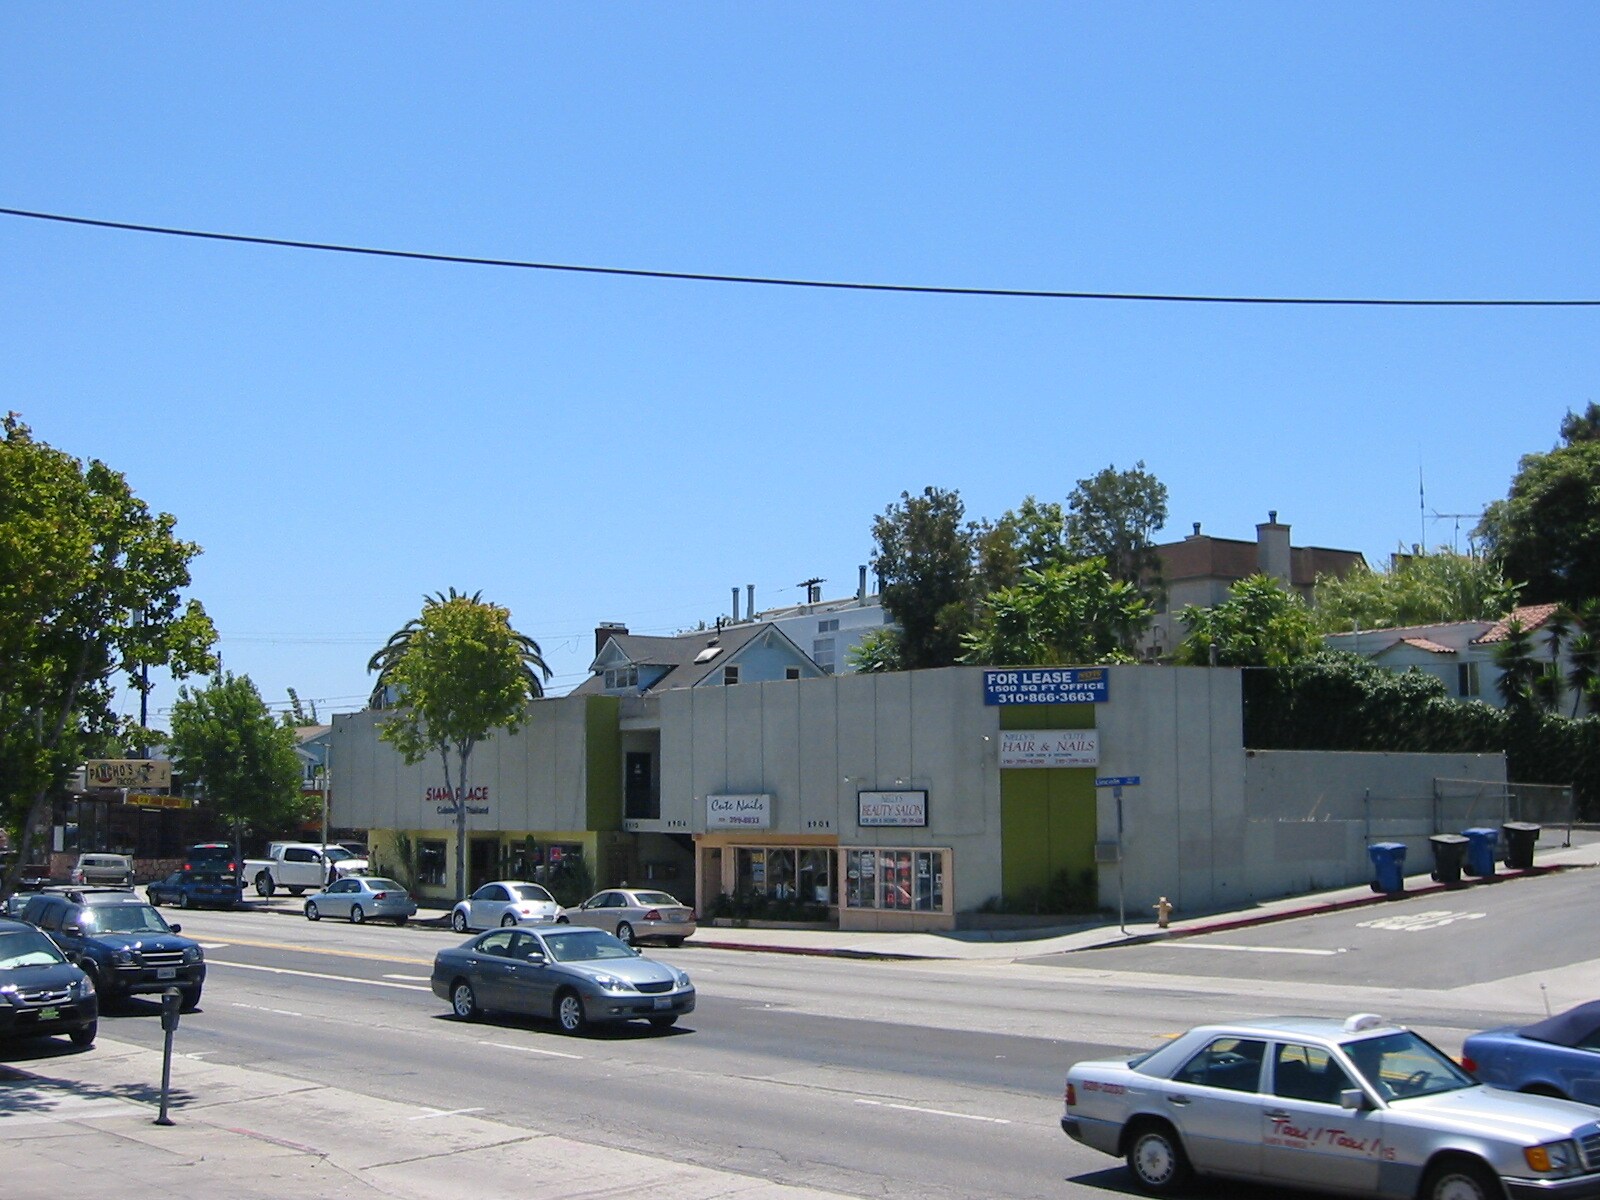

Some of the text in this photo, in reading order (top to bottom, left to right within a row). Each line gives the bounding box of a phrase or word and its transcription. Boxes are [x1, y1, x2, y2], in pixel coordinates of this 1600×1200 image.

[987, 673, 1018, 685] FOR
[1022, 672, 1072, 684] LEASE
[988, 682, 1105, 693] 1500 SQ FT OFFICE
[1002, 741, 1095, 752] HAIR & NAILS
[89, 763, 133, 780] PANCHO'S
[456, 787, 489, 800] PACE
[711, 798, 763, 811] Cute Nails
[862, 804, 922, 816] BEAUTY SALON
